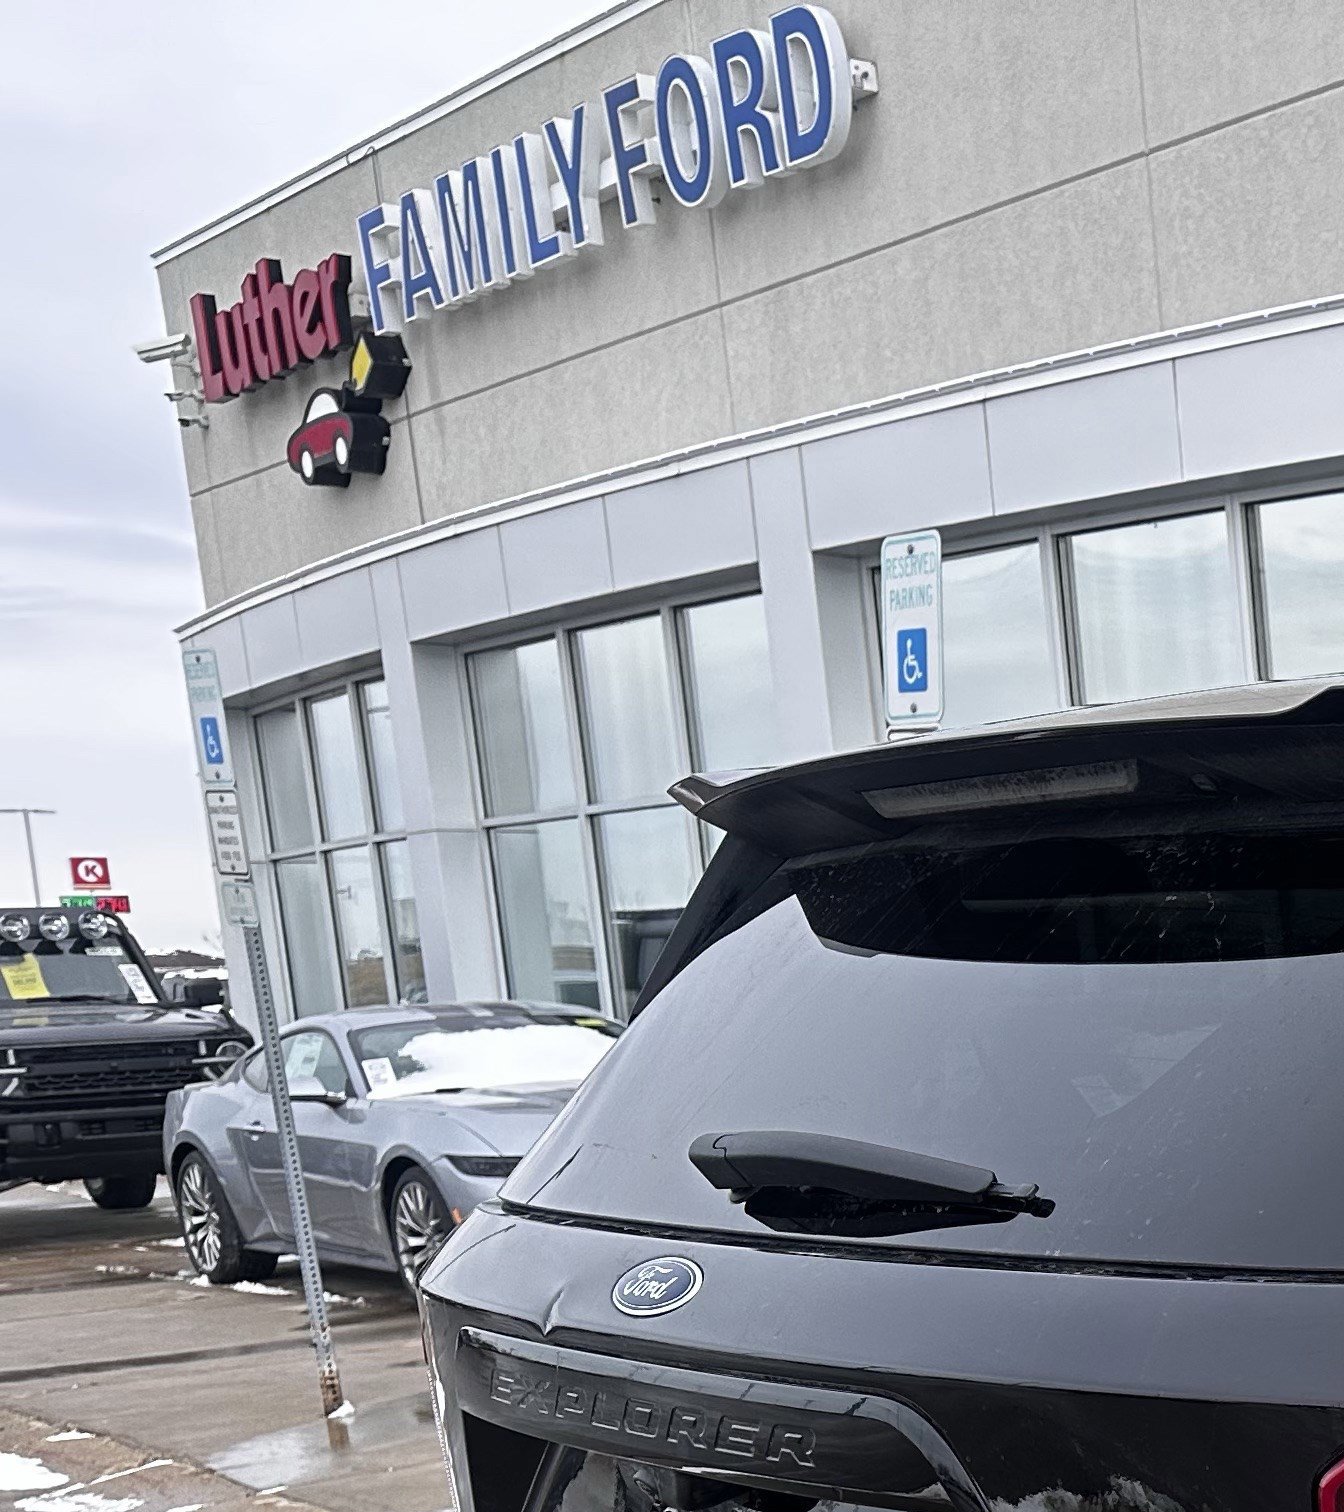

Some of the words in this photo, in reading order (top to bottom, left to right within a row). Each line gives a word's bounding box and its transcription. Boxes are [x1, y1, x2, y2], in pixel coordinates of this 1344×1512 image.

[189, 252, 353, 404] Luther
[357, 102, 597, 336] FAMILY
[603, 4, 846, 227] FORD
[885, 551, 937, 581] RESERVED
[889, 583, 934, 613] PARKING
[490, 1366, 817, 1469] EXPLORER
